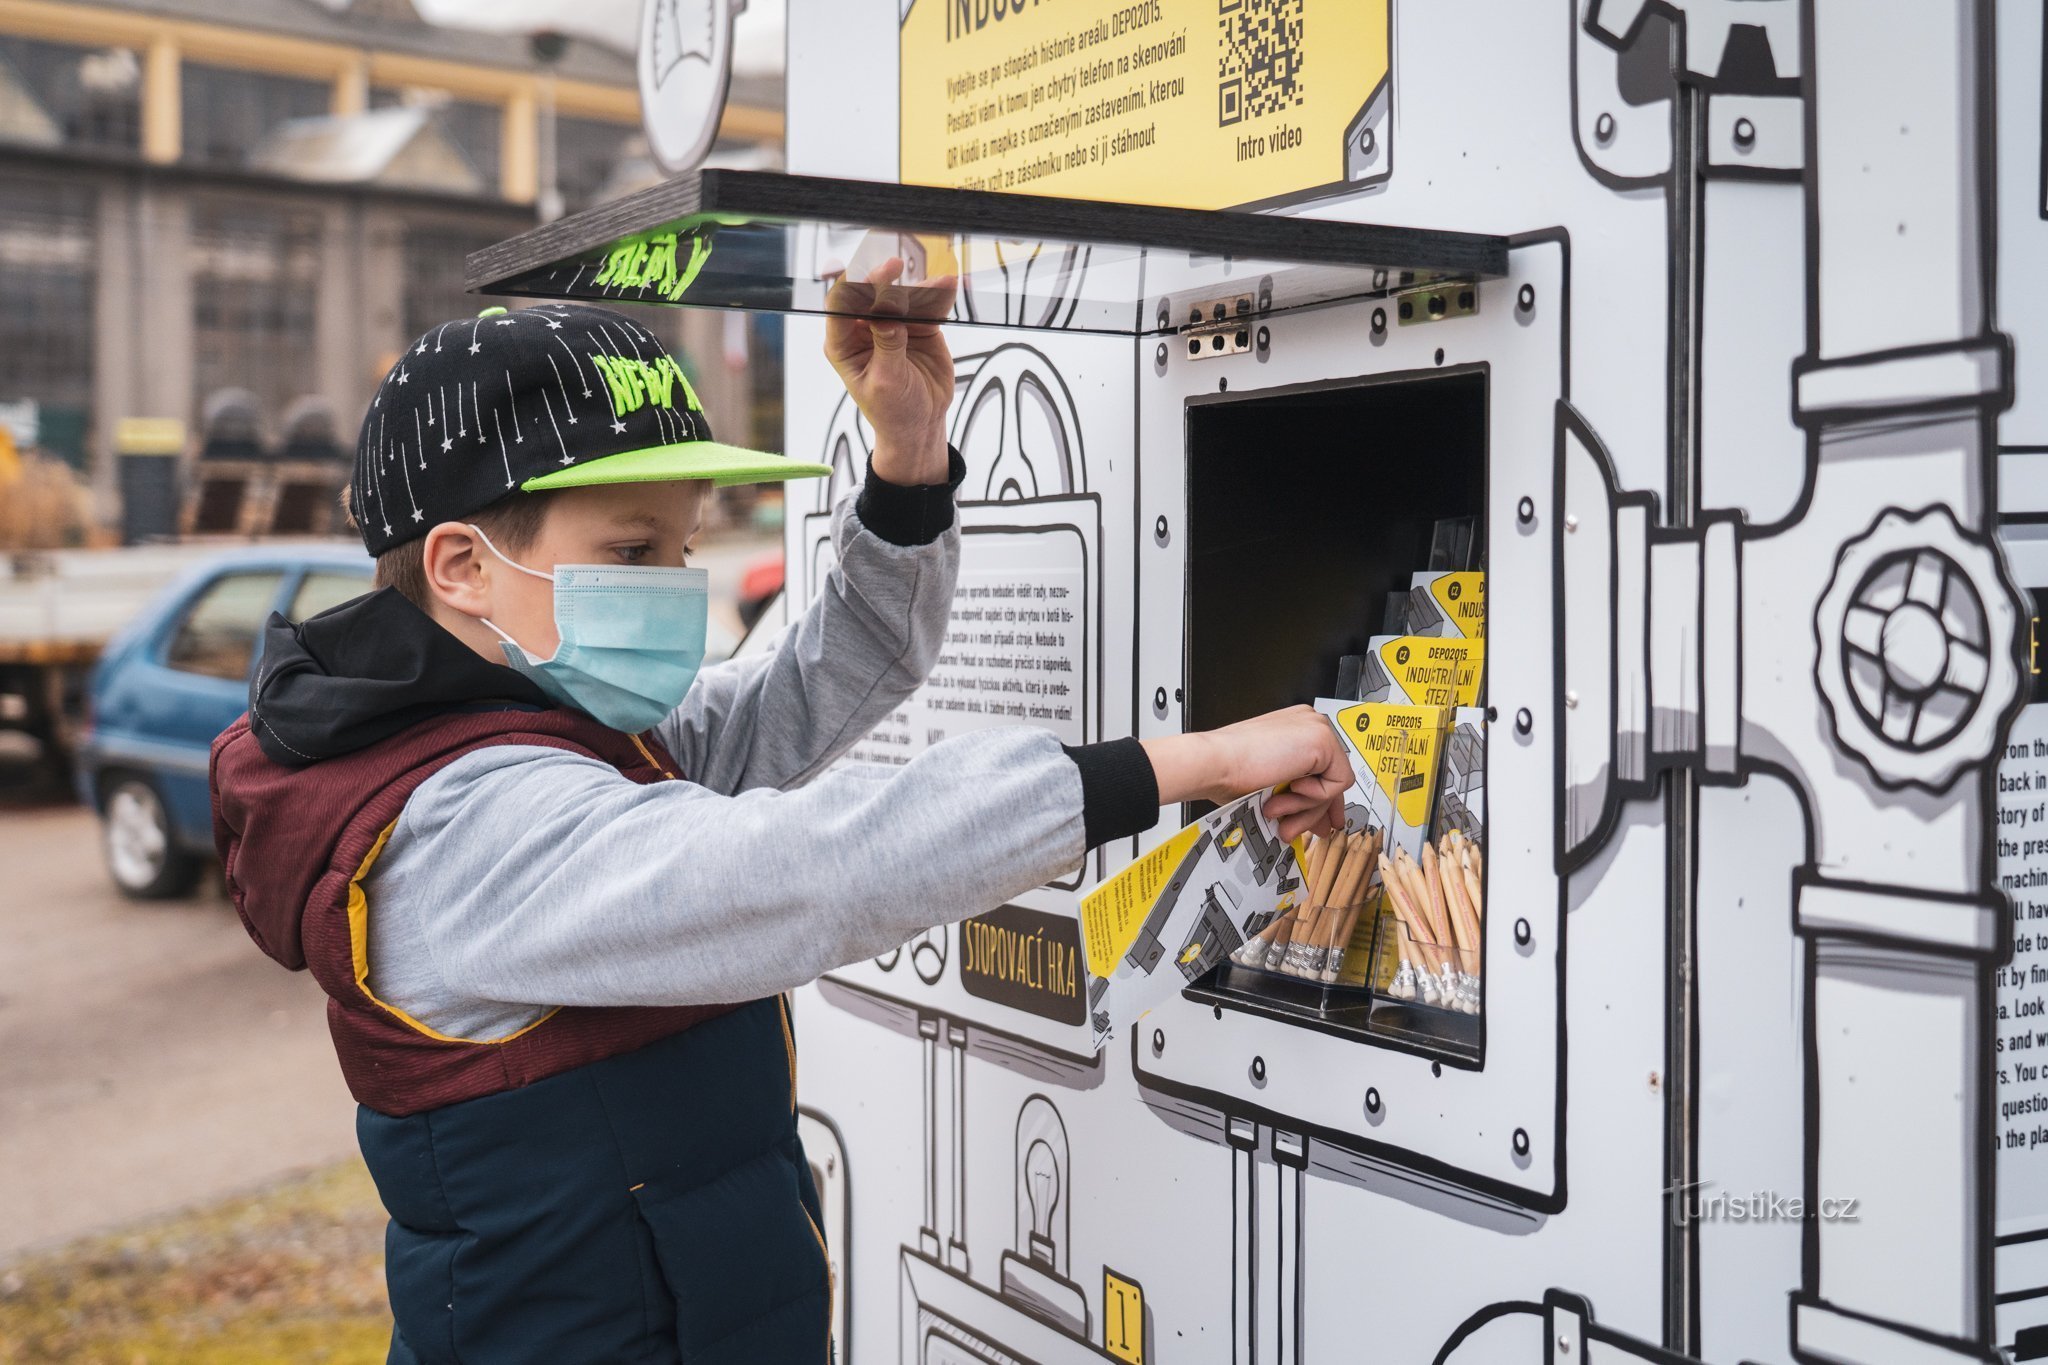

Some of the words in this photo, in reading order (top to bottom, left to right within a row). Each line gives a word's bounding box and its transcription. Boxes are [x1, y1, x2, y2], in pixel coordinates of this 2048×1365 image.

[979, 69, 988, 88] se
[990, 65, 1001, 89] po
[1003, 46, 1037, 80] stopách
[1041, 32, 1075, 65] historie
[1078, 19, 1109, 51] areálu
[1112, 0, 1163, 38] DEPO2015.
[979, 99, 997, 123] vám
[998, 95, 1004, 116] k
[1006, 91, 1028, 114] tomu
[1031, 83, 1045, 112] jen
[1047, 66, 1077, 103] chytrý
[1080, 58, 1114, 88] telefon
[1117, 55, 1129, 76] na
[1132, 27, 1187, 70] skenování
[946, 147, 958, 170] QR
[982, 142, 988, 159] a
[990, 128, 1018, 159] mapka
[1020, 130, 1026, 146] s
[1028, 104, 1082, 143] označenými
[1085, 86, 1147, 126] zastaveními,
[1149, 77, 1185, 105] kterou
[1236, 135, 1265, 163] Intro
[1268, 123, 1302, 153] video
[1005, 170, 1015, 188] ze
[1017, 152, 1062, 185] zásobníku
[1064, 144, 1087, 171] nebo
[1090, 137, 1099, 162] si
[1101, 135, 1108, 166] ji
[1111, 122, 1156, 157] stáhnout
[1033, 584, 1047, 602] rady,
[1049, 587, 1070, 598] nezou-
[1018, 608, 1040, 625] ukrytou
[1047, 607, 1060, 622] botě
[1061, 608, 1074, 622] his-
[1016, 631, 1034, 649] stroje.
[1036, 631, 1057, 647] Nebude
[1058, 633, 1065, 647] to
[1015, 653, 1035, 673] přečíst
[1036, 655, 1041, 670] si
[1043, 656, 1072, 674] nápovědu,
[1428, 647, 1468, 661] DEPO2015
[1026, 678, 1041, 694] která
[1042, 680, 1048, 698] je
[1050, 681, 1070, 696] uvede-
[1029, 703, 1052, 719] všechno
[1055, 704, 1073, 720] vidím!
[1386, 715, 1422, 729] DEPO2015
[2003, 744, 2029, 759] rom
[2000, 772, 2031, 793] back
[2035, 770, 2047, 790] in
[1996, 807, 2027, 828] story
[2032, 802, 2045, 822] of
[1998, 839, 2018, 857] the
[2023, 840, 2048, 861] pres
[2002, 867, 2048, 889] machin
[2014, 901, 2024, 921] ll
[2028, 900, 2048, 919] hav
[966, 920, 1044, 989] STOPOVACÍ
[1048, 940, 1076, 998] HRA
[2011, 966, 2026, 991] by
[2031, 964, 2048, 984] fin
[2015, 995, 2045, 1018] Look
[1996, 1038, 2004, 1053] s
[2009, 1029, 2032, 1051] and
[2036, 1032, 2048, 1047] w
[2015, 1062, 2037, 1082] You
[2042, 1064, 2048, 1079] c
[2002, 1092, 2048, 1121] questio
[2006, 1128, 2026, 1149] the
[2030, 1124, 2048, 1151] pla
